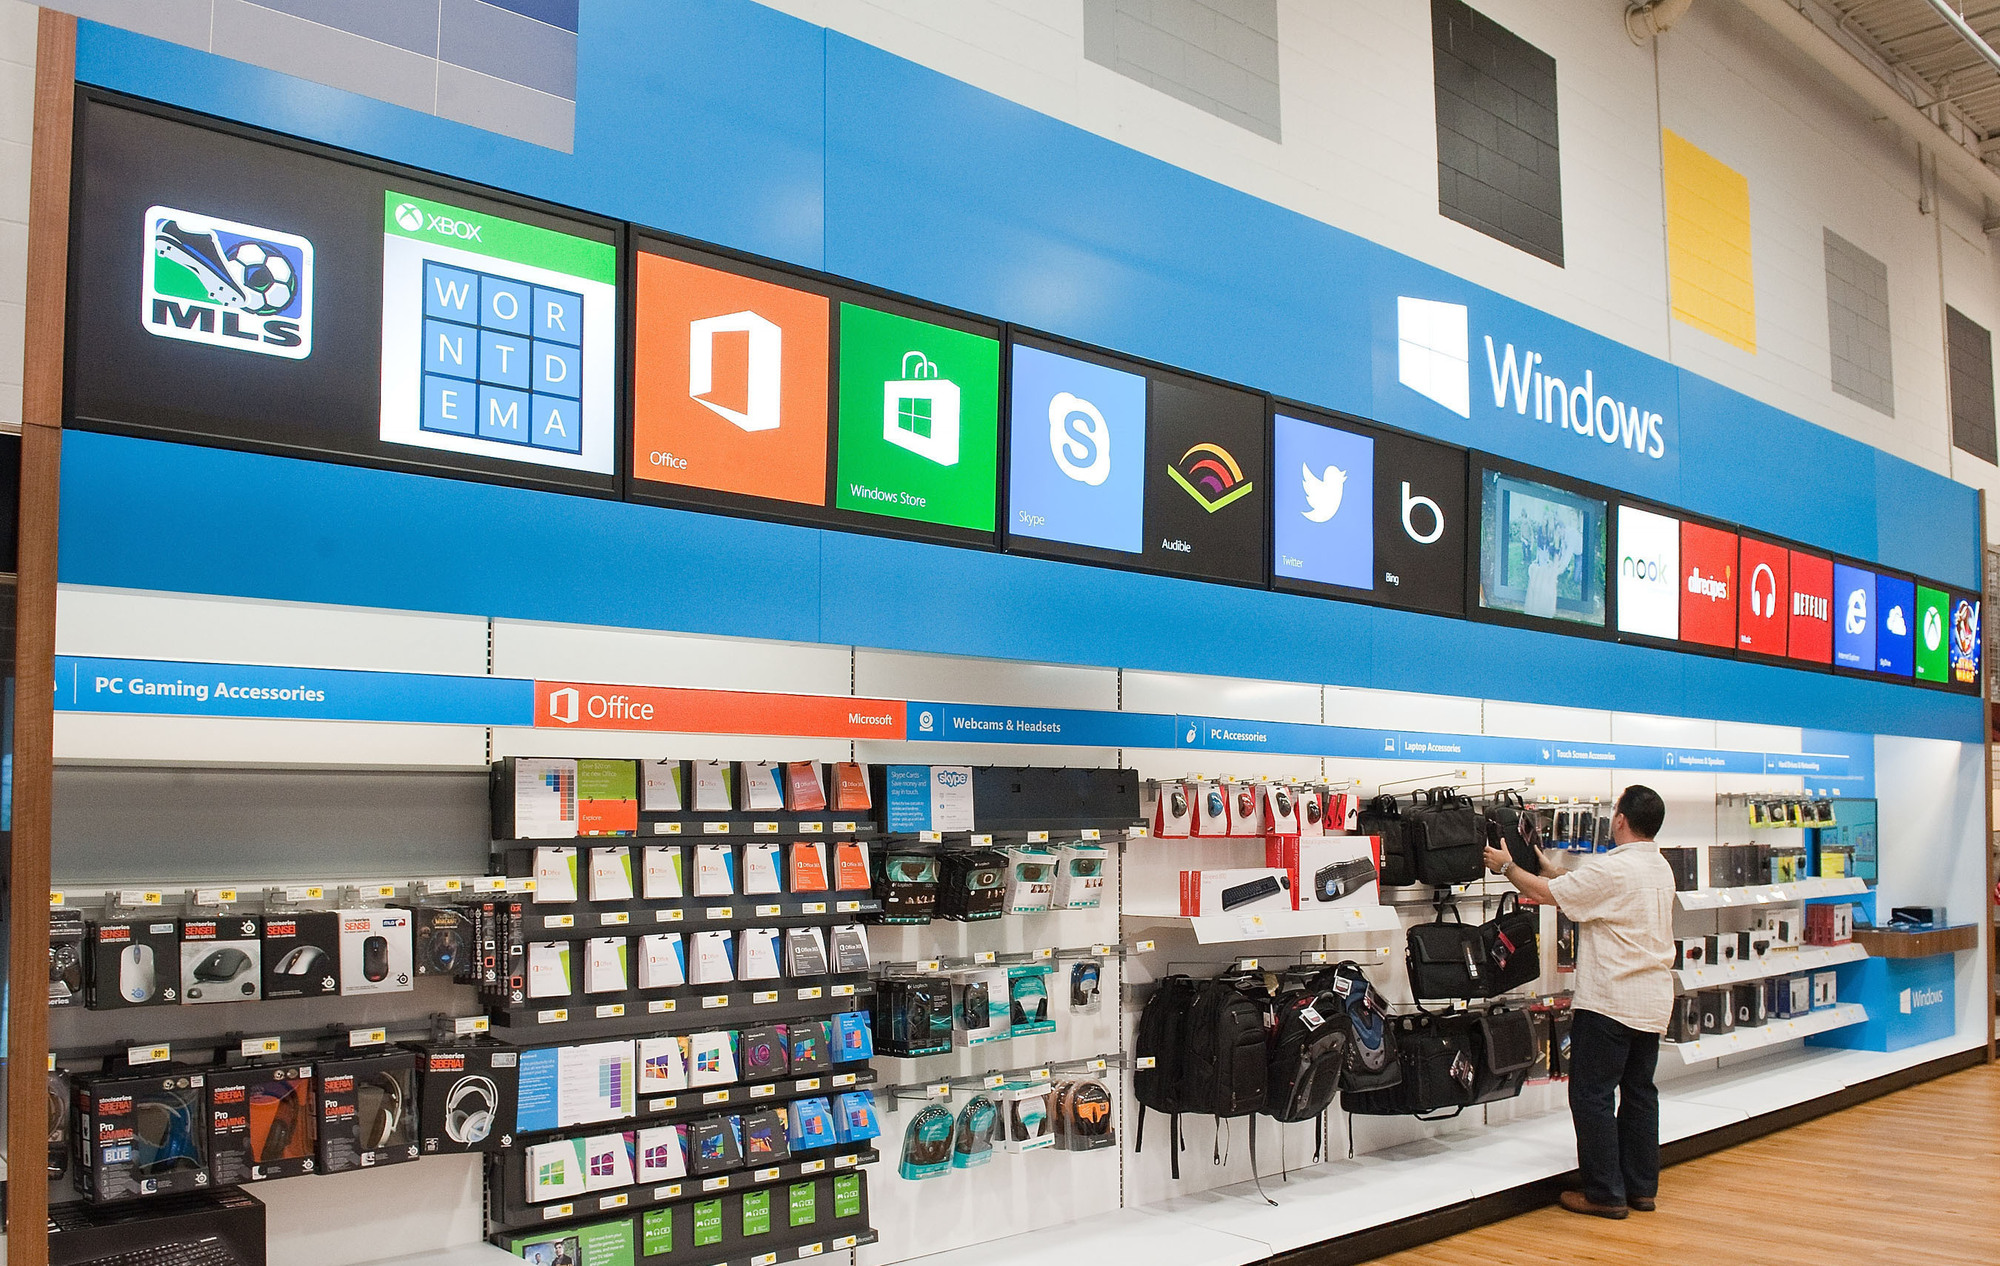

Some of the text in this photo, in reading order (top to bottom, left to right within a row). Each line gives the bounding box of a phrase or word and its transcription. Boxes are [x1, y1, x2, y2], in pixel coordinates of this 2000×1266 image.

[427, 213, 483, 243] XBOX
[152, 298, 302, 348] MLS
[1484, 335, 1665, 460] Windows
[650, 451, 688, 470] Office
[850, 483, 926, 507] Windows Store
[1019, 510, 1045, 527] Skype
[1161, 537, 1191, 554] Audible
[1281, 554, 1304, 569] Twitter
[1623, 554, 1668, 585] nook
[1385, 571, 1399, 586] Bing
[1793, 591, 1828, 622] NETFLIX
[95, 677, 325, 702] PC Gaming Accessories
[587, 694, 655, 720] Office
[848, 711, 893, 726] Microsoft
[953, 717, 1061, 734] Webcams & Headsets
[1211, 729, 1267, 743] PC Accessories
[1404, 741, 1461, 754] Laptop Accessories
[939, 771, 967, 787] skype
[267, 926, 296, 935] SENSEI
[345, 922, 370, 931] SENSEI
[1912, 988, 1943, 1008] Windows
[325, 1100, 337, 1108] Pro
[326, 1105, 354, 1116] GAMING
[215, 1111, 228, 1120] Pro
[215, 1117, 245, 1127] GAMING
[100, 1123, 114, 1132] Pro
[100, 1129, 133, 1140] GAMING
[105, 1150, 130, 1162] BLUE
